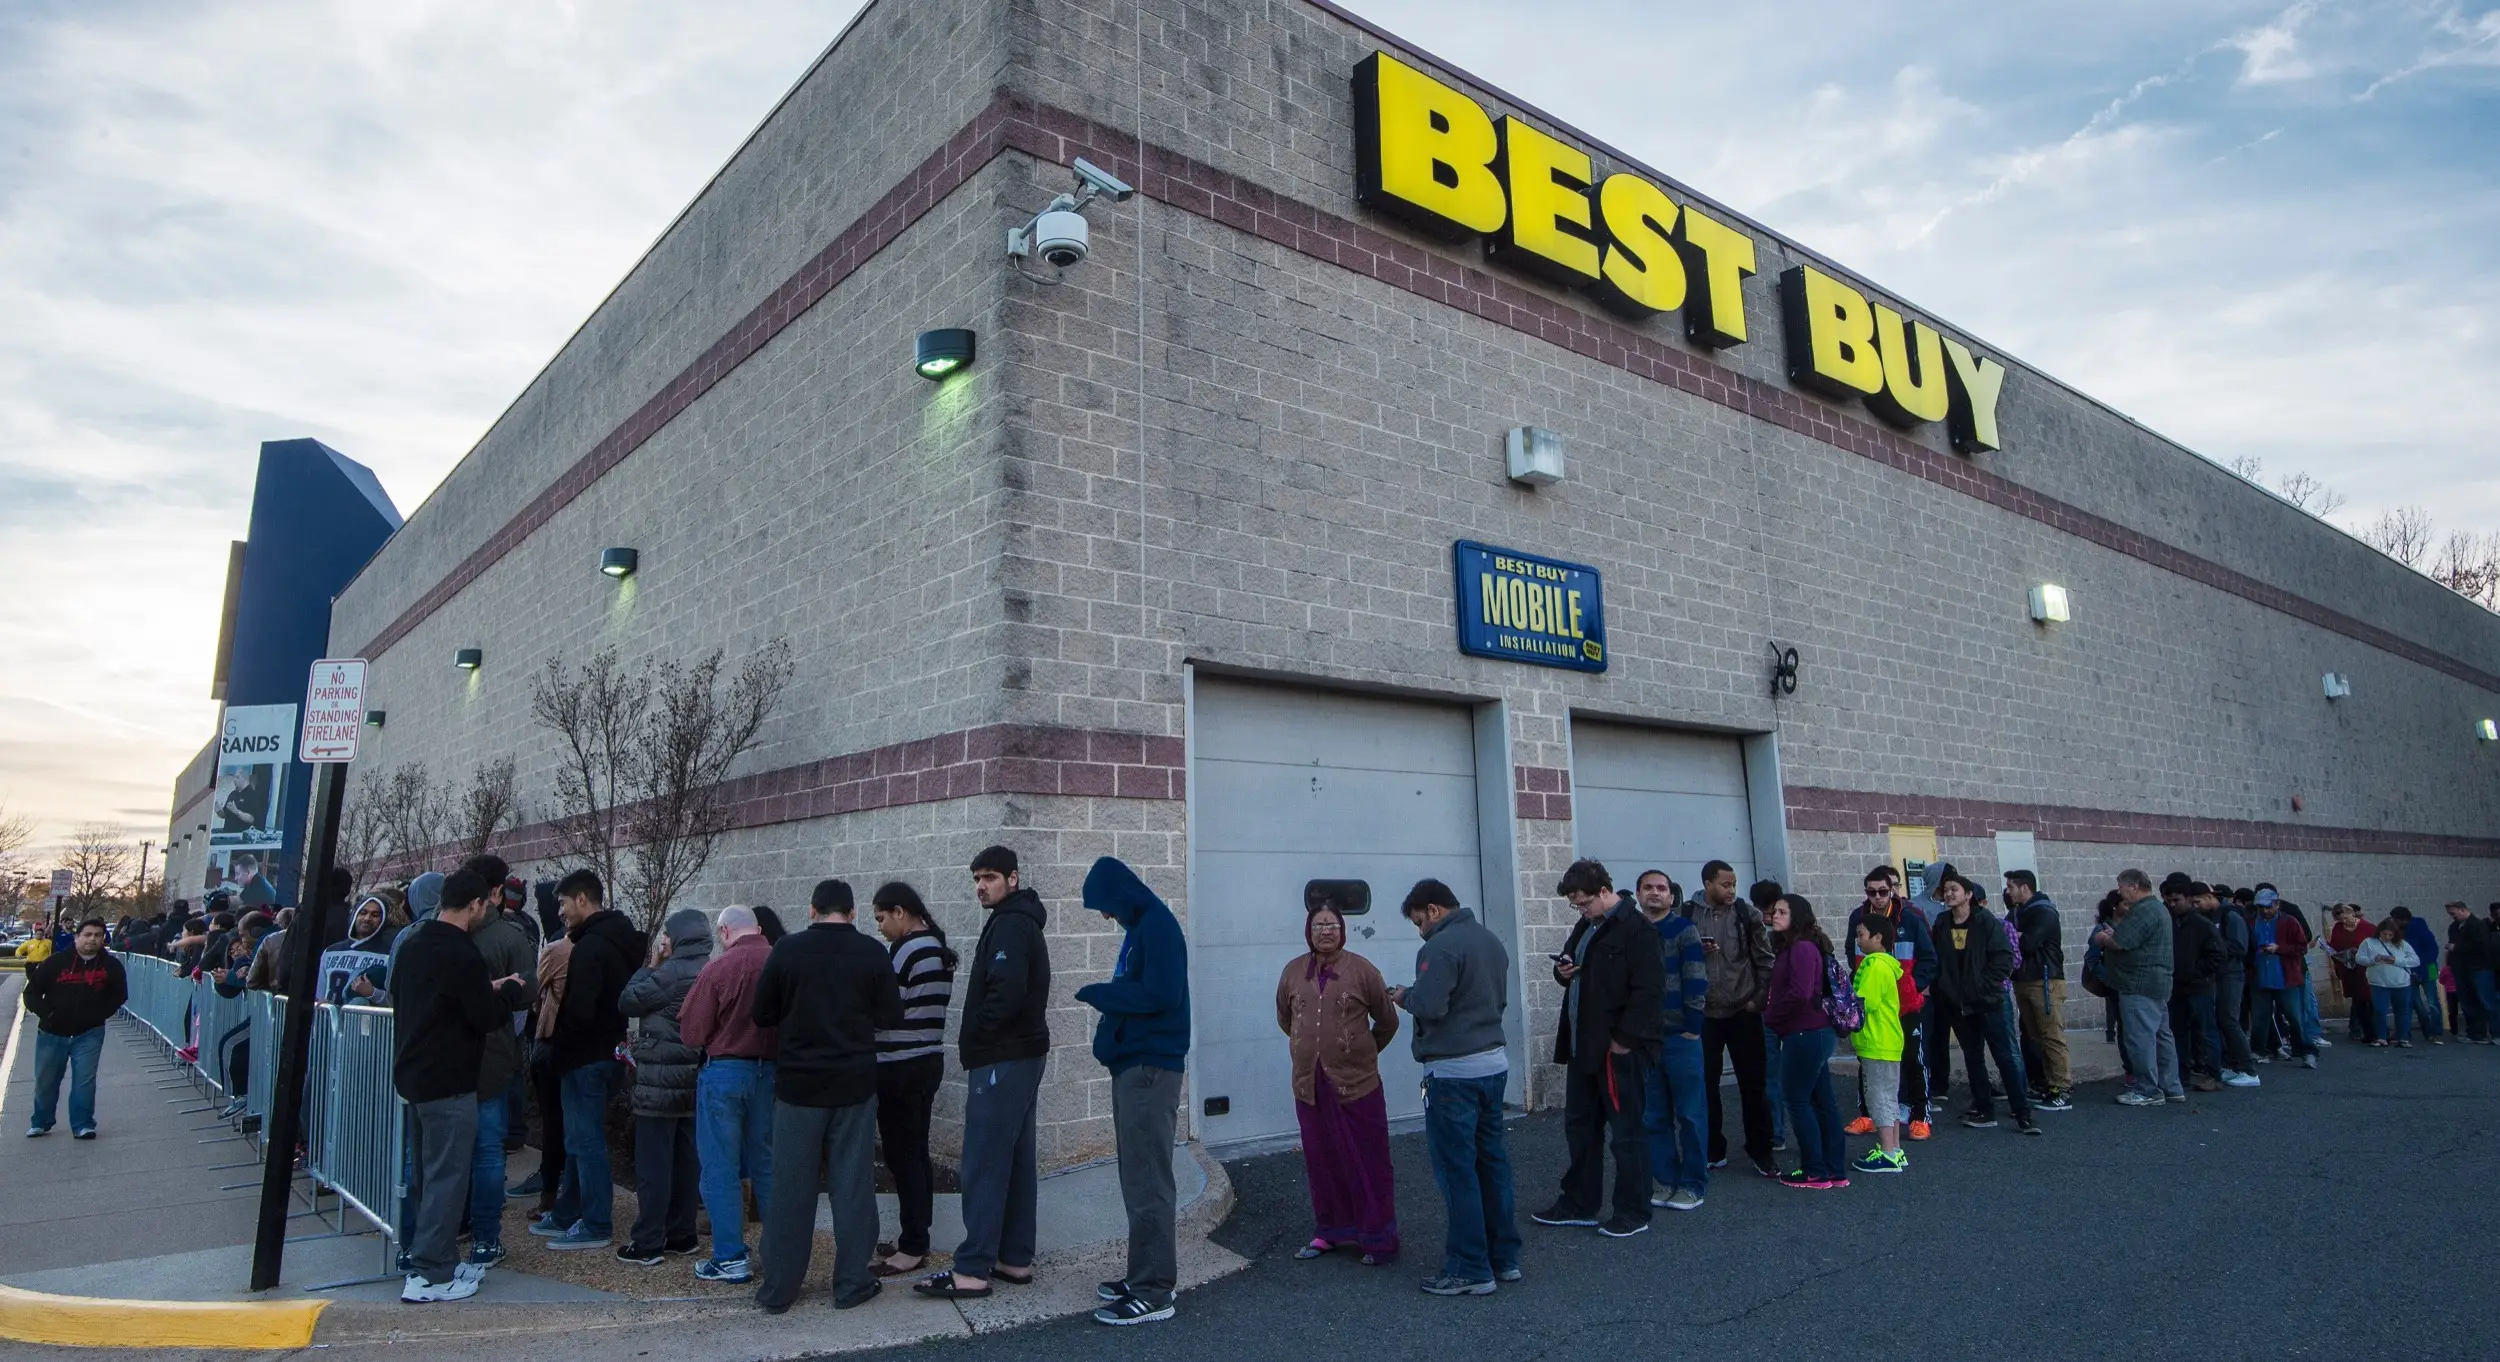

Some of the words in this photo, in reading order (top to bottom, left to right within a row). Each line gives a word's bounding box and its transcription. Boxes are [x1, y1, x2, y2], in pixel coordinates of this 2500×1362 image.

[1374, 50, 1757, 346] BEST
[1802, 264, 2005, 452] BUY
[1495, 557, 1533, 577] BEST
[1536, 565, 1568, 582] BUY
[1481, 573, 1583, 639] MOBILE
[1500, 634, 1576, 659] INSTALLATION
[331, 672, 345, 685] NO
[314, 687, 358, 700] PARKING
[309, 710, 358, 723] STANDING
[306, 725, 356, 741] FIRELANE
